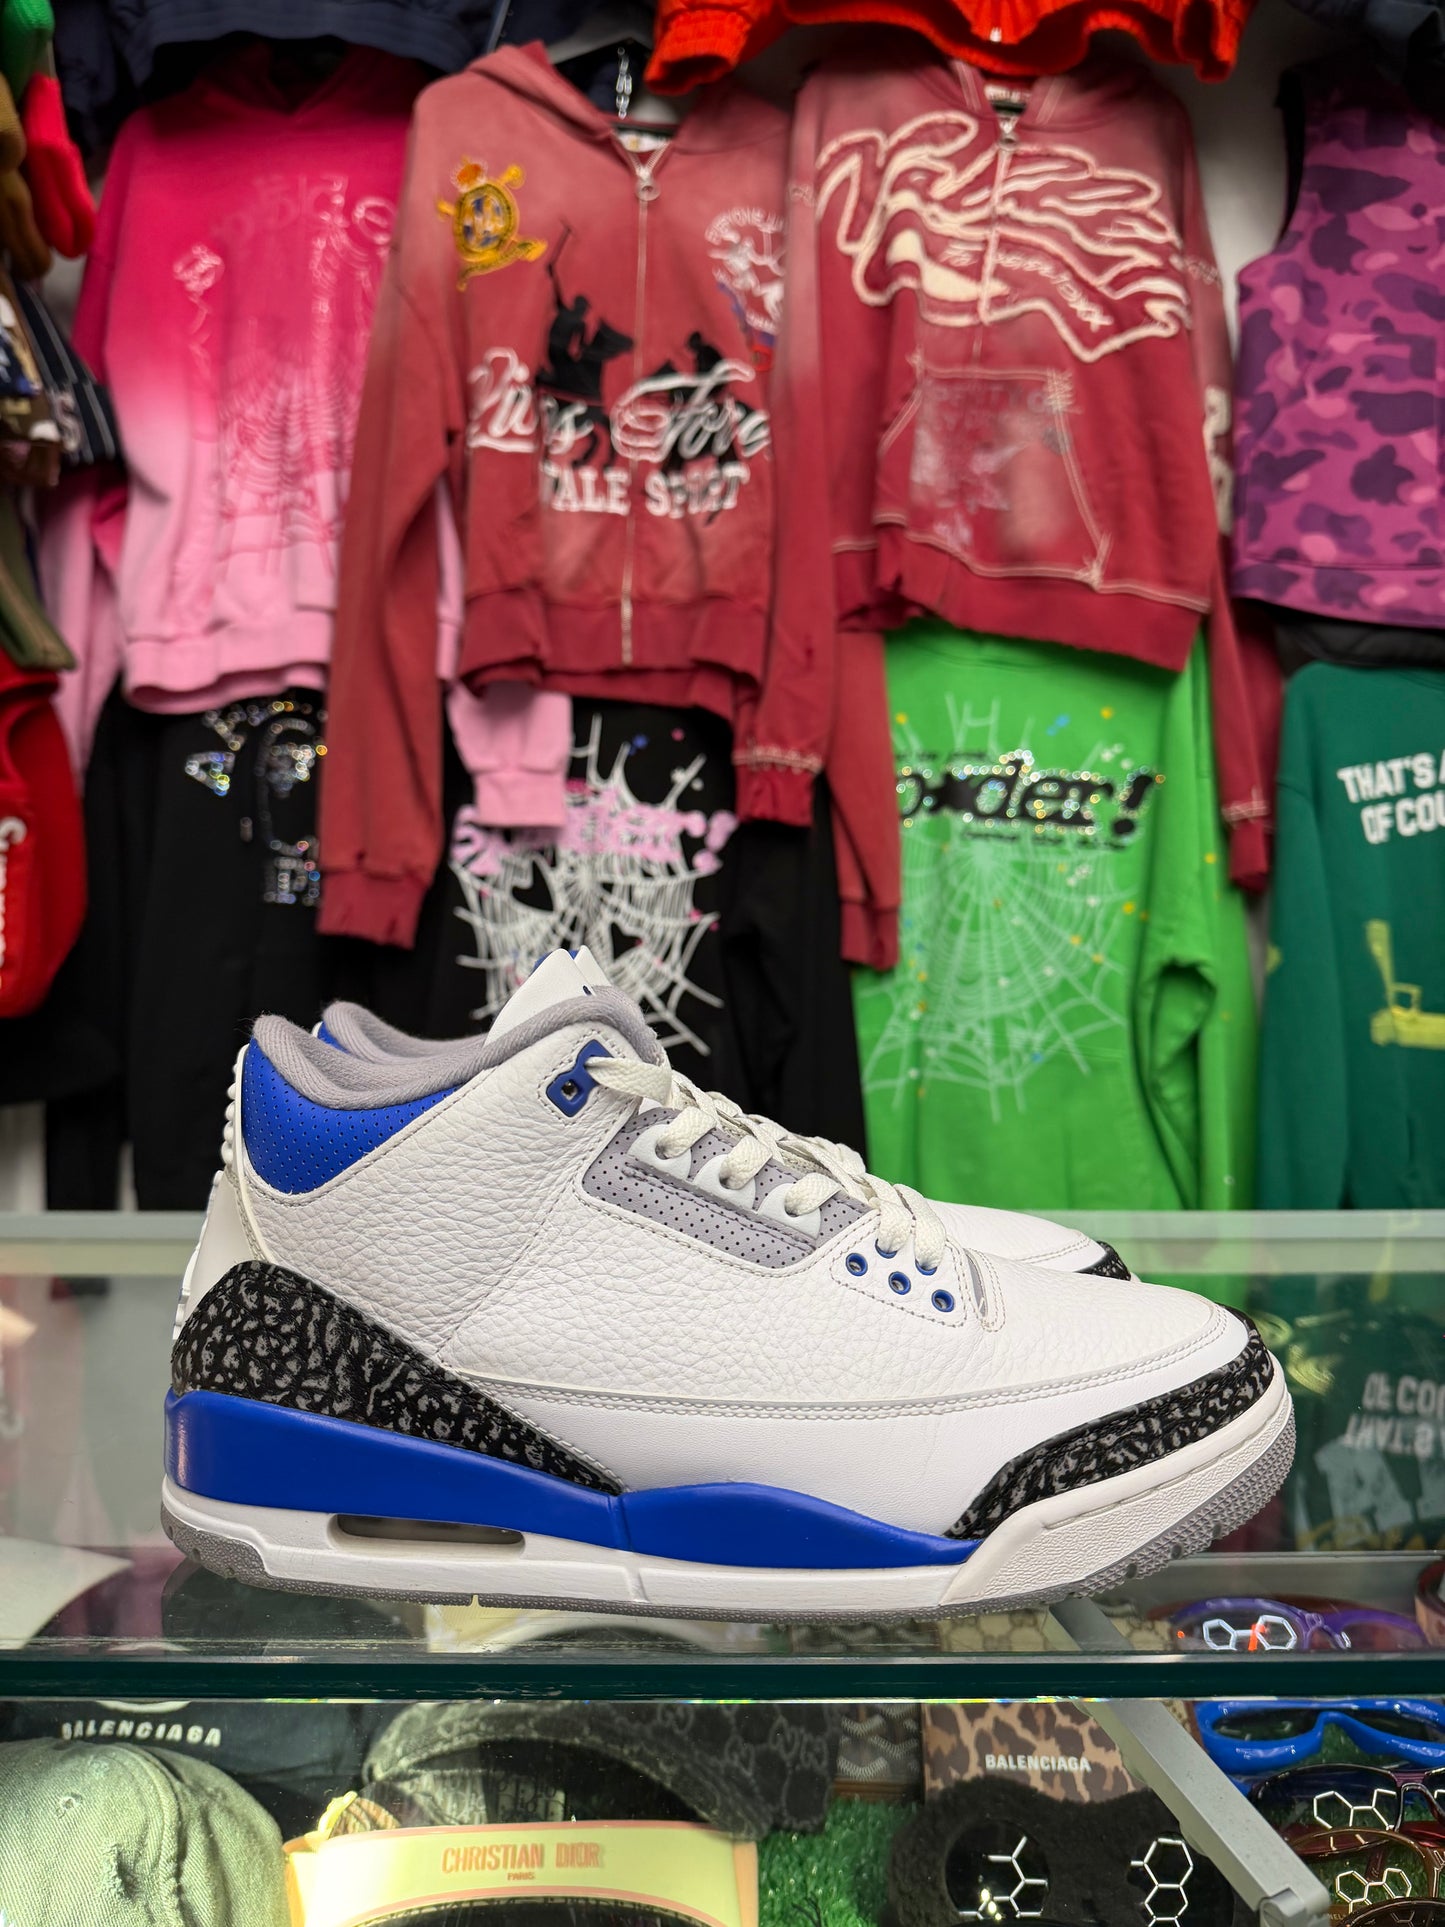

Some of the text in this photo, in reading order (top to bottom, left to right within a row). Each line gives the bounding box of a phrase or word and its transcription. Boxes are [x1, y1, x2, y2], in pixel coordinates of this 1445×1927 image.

[1336, 752, 1436, 803] THAT'S
[1360, 801, 1393, 844] OF
[61, 1719, 221, 1747] BALENCIAGA
[985, 1753, 1092, 1773] BALENCIAGA
[441, 1841, 603, 1874] CHRISTIAN DIOR
[507, 1871, 535, 1881] PARIS
